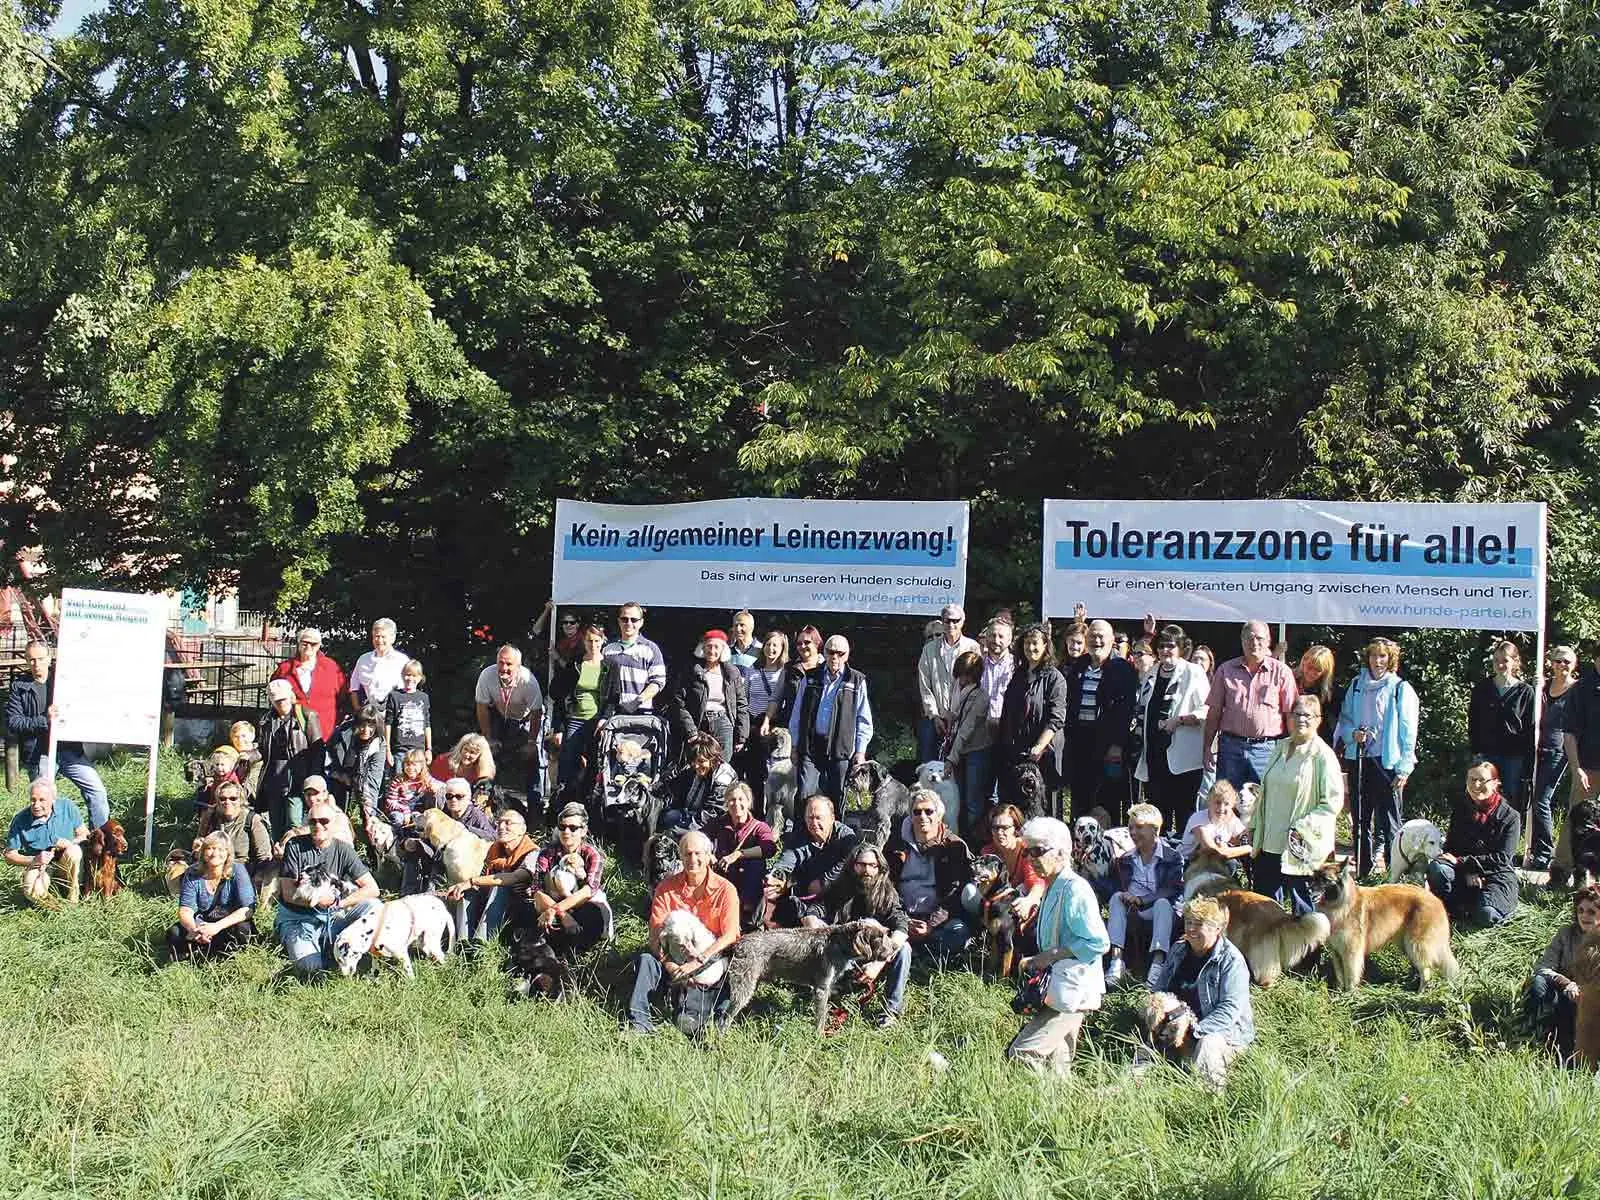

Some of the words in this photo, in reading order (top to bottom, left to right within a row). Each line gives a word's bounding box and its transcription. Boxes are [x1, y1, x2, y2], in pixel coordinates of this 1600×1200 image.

[571, 522, 620, 548] Kein
[626, 522, 765, 553] allgemeiner
[773, 523, 954, 556] Leinenzwang!
[1066, 520, 1332, 560] Toleranzzone
[1347, 523, 1408, 563] für
[1424, 525, 1516, 564] alle!
[701, 570, 725, 582] Das
[729, 571, 756, 583] sind
[759, 572, 778, 583] wir
[782, 574, 836, 585] unseren
[841, 574, 892, 586] Hunden
[896, 574, 956, 589] schuldig.
[1097, 576, 1121, 589] Für
[1125, 578, 1165, 591] einen
[1168, 579, 1245, 593] toleranten
[1249, 580, 1314, 595] Umgang
[1318, 582, 1392, 596] zwischen
[1396, 584, 1459, 597] Mensch
[1463, 585, 1495, 598] und
[1499, 586, 1533, 599] Tier.
[811, 589, 956, 606] www.hunde-partei.ch
[1357, 603, 1533, 620] www.hunde-partei.ch
